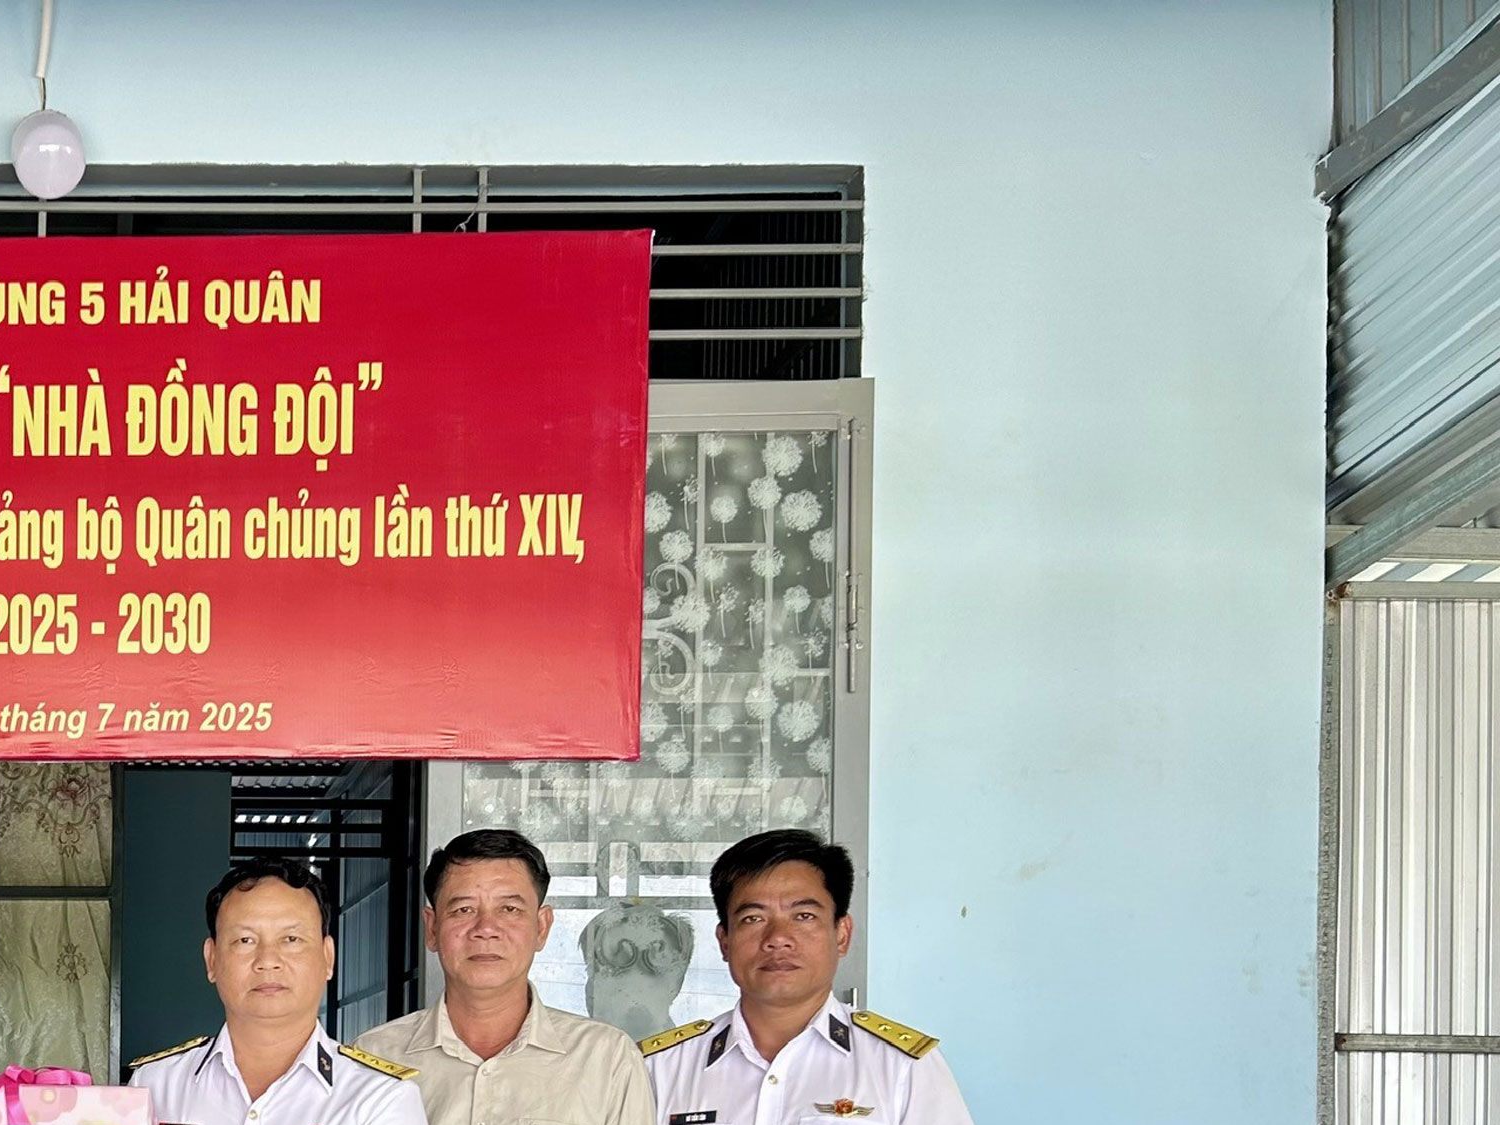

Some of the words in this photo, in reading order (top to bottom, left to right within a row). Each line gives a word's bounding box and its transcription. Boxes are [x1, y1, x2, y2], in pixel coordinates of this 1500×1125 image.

[81, 283, 104, 324] 5
[120, 267, 188, 323] HẢI
[205, 271, 320, 328] QUÂN
[126, 359, 257, 456] ĐỒNG
[274, 363, 382, 470] ĐỘI”
[77, 497, 122, 574] bộ
[136, 496, 230, 566] Quân
[245, 489, 360, 566] chủng
[375, 485, 432, 557] lần
[446, 494, 508, 557] thứ
[518, 495, 584, 563] XIV,
[91, 622, 105, 634] -
[118, 593, 210, 654] 2030
[0, 704, 86, 739] tháng
[98, 703, 115, 732] 7
[124, 703, 189, 732] năm
[200, 702, 272, 731] 2025
